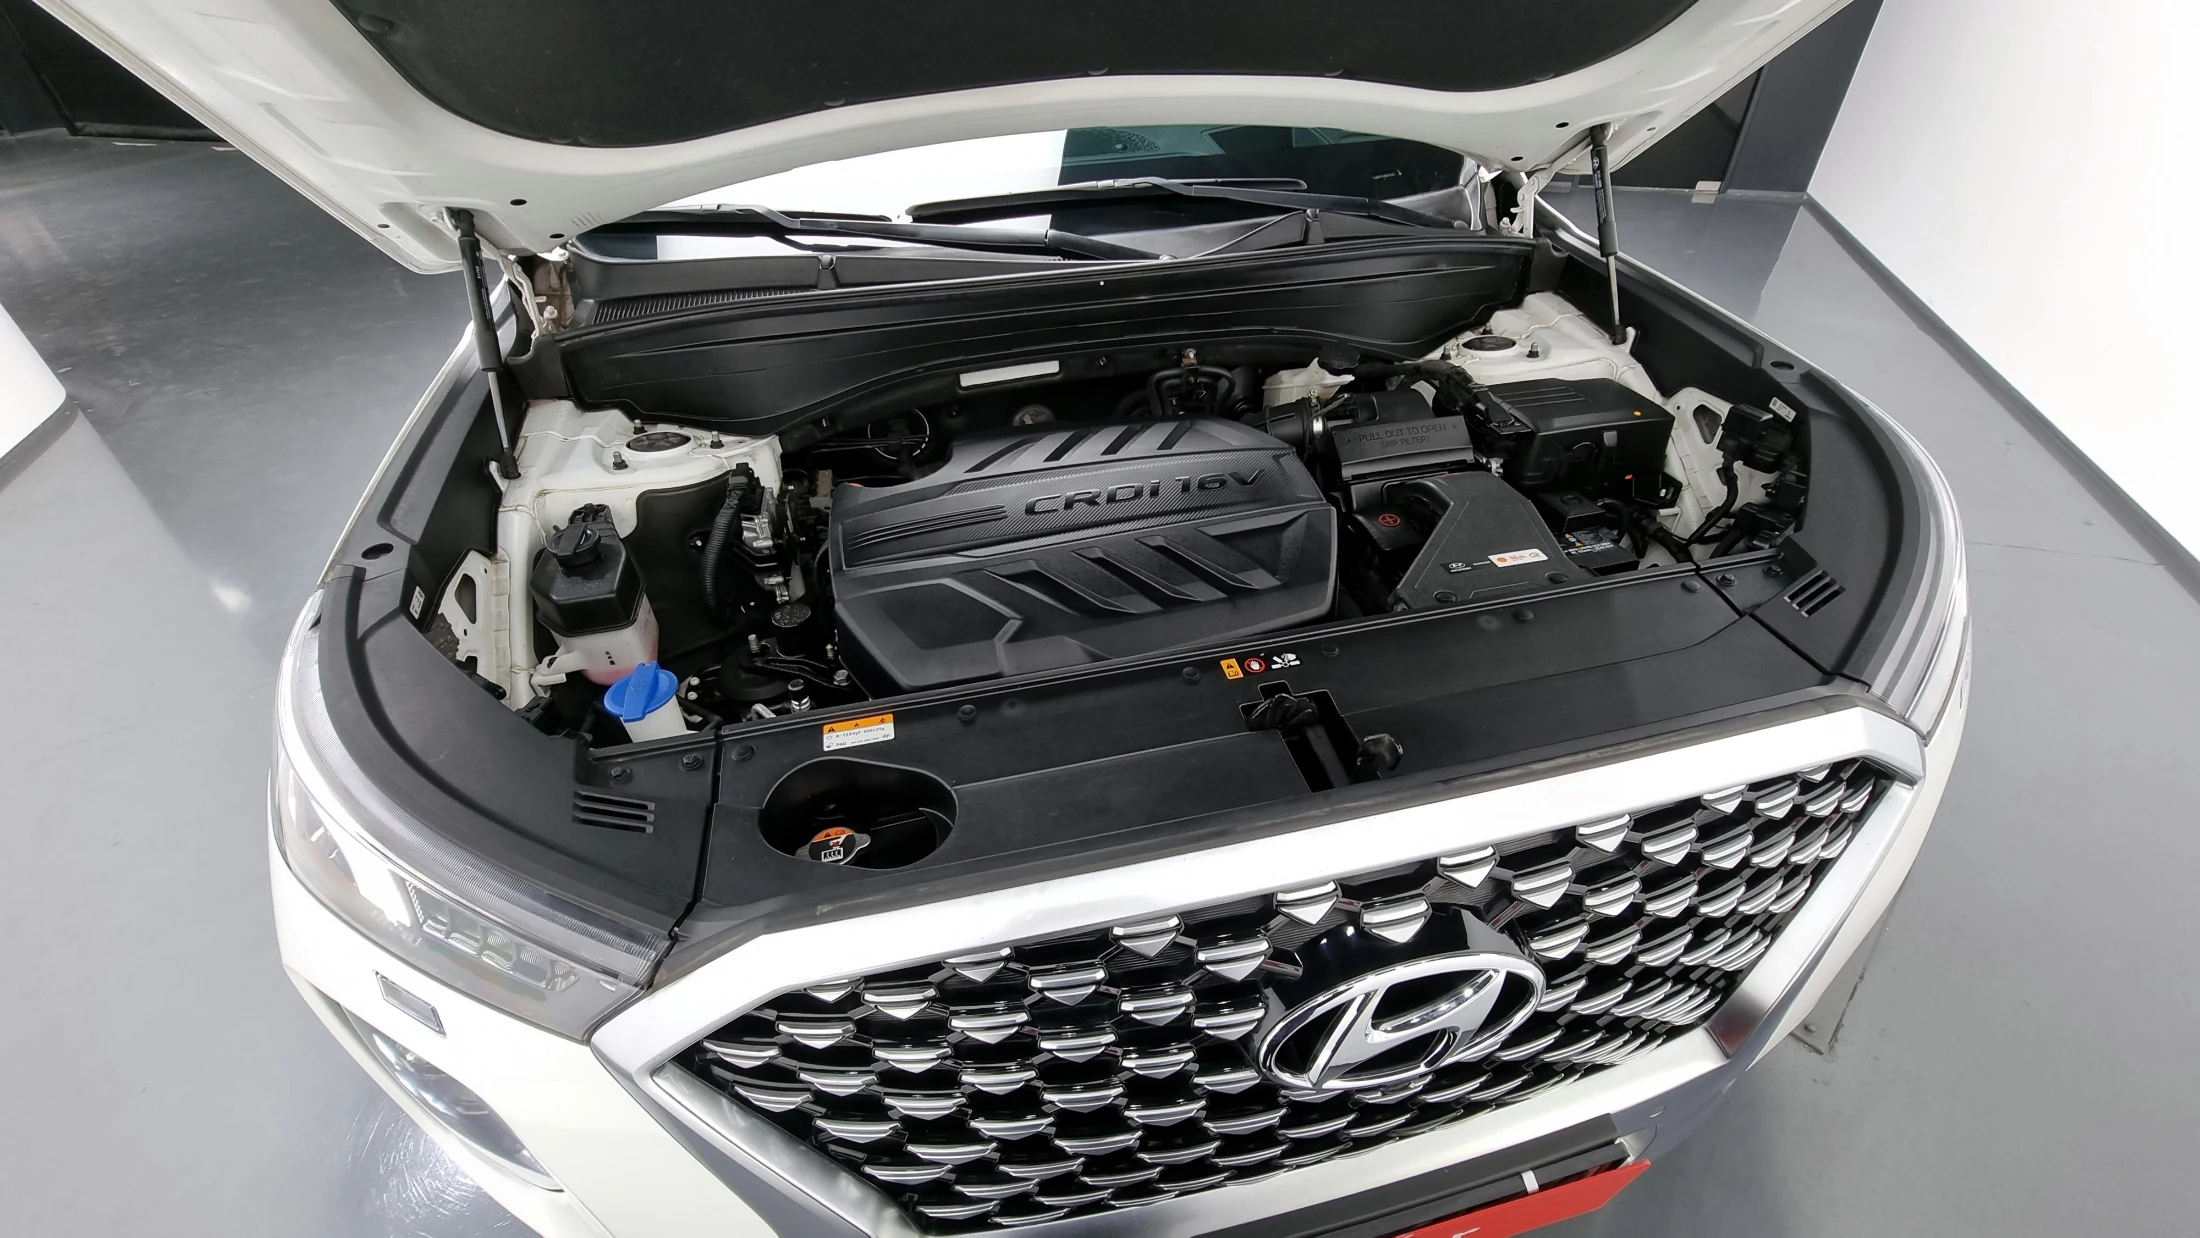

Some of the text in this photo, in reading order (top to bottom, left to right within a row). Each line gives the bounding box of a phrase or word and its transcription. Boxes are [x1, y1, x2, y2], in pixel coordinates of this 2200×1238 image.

[1358, 423, 1447, 442] PULL OUT TO OPEN
[1174, 468, 1265, 495] 16V
